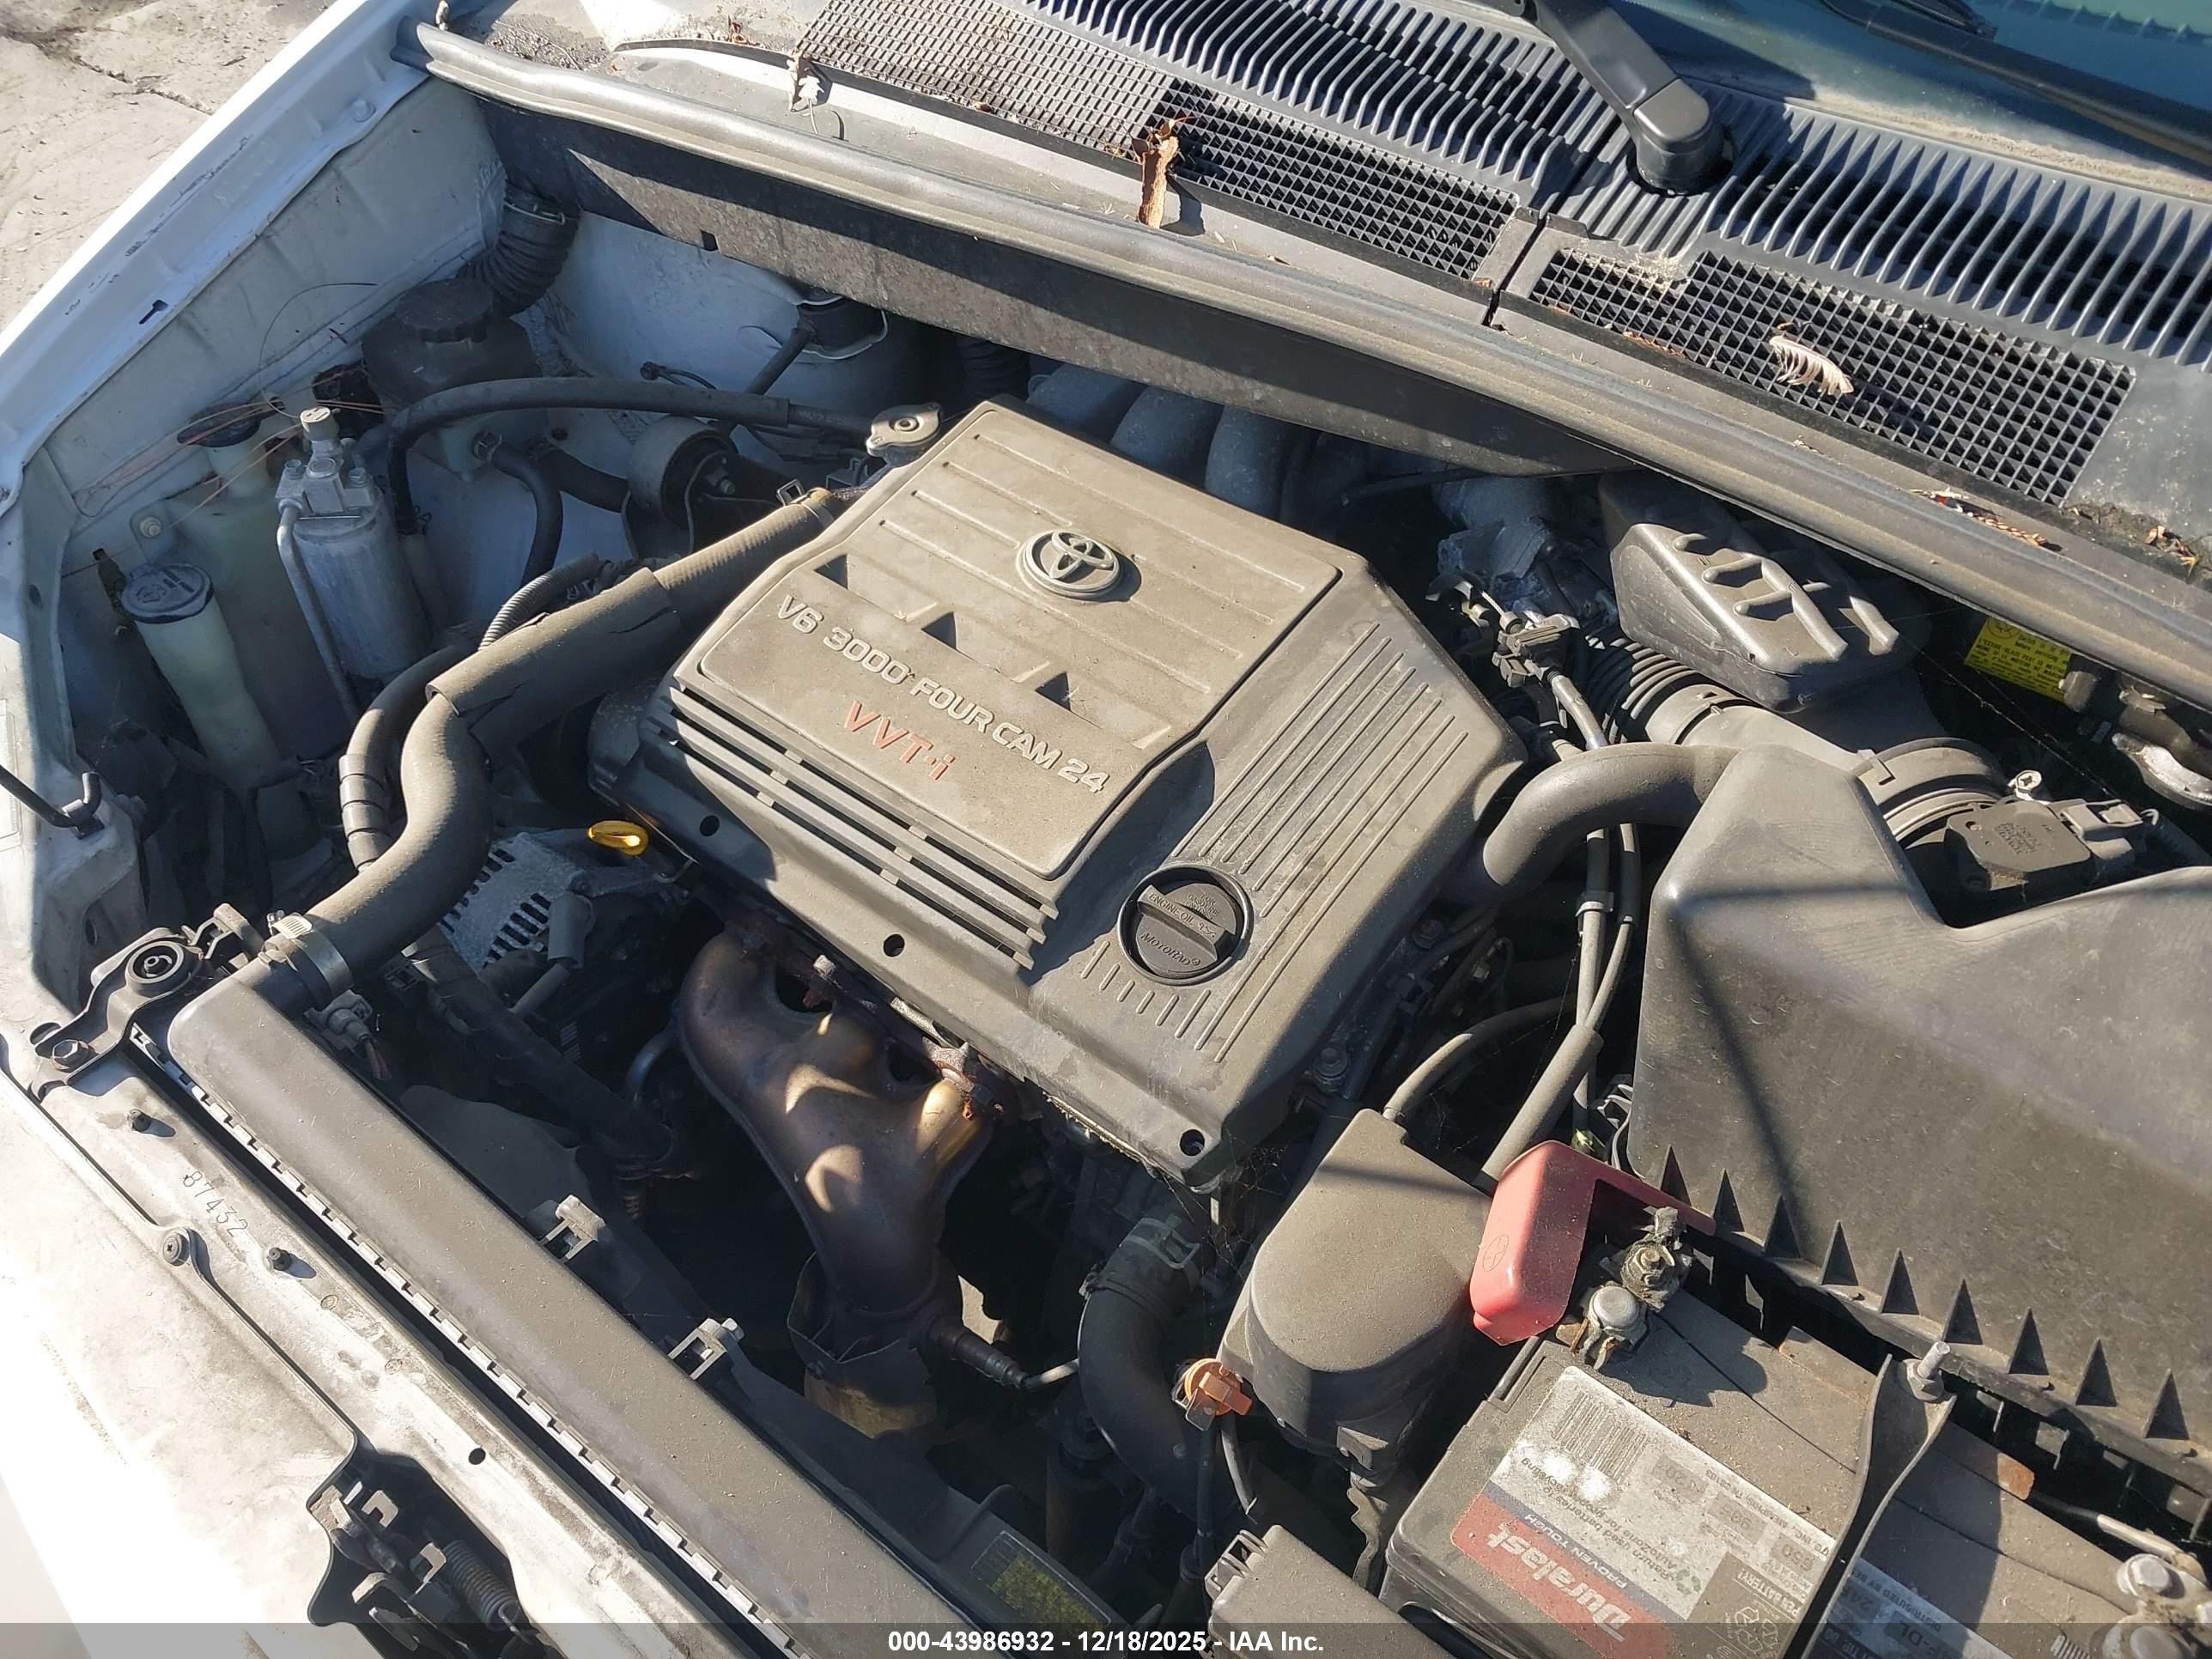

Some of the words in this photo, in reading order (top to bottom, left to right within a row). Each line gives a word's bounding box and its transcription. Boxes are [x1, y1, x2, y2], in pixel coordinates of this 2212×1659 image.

[778, 594, 824, 633] V6
[823, 627, 911, 684] 3000
[910, 678, 994, 733] FOUR
[993, 722, 1062, 769] CAM
[1058, 757, 1109, 793] 24
[1149, 893, 1180, 914] ENGINE
[1181, 912, 1194, 926] OIL
[1200, 893, 1217, 905] FOR
[183, 1171, 248, 1237] 87432
[1542, 1487, 1553, 1498] to
[1554, 1495, 1601, 1531] batteries
[1606, 1518, 1620, 1531] for
[1524, 1514, 1569, 1547] TOUGH
[1603, 1528, 1630, 1551] used
[1622, 1529, 1676, 1570] AutoZone
[1632, 1549, 1669, 1578] Return
[1487, 1522, 1632, 1642] Duralast
[1571, 1547, 1628, 1589] PROVEN
[1883, 1589, 1941, 1631] DISTRIBUTED
